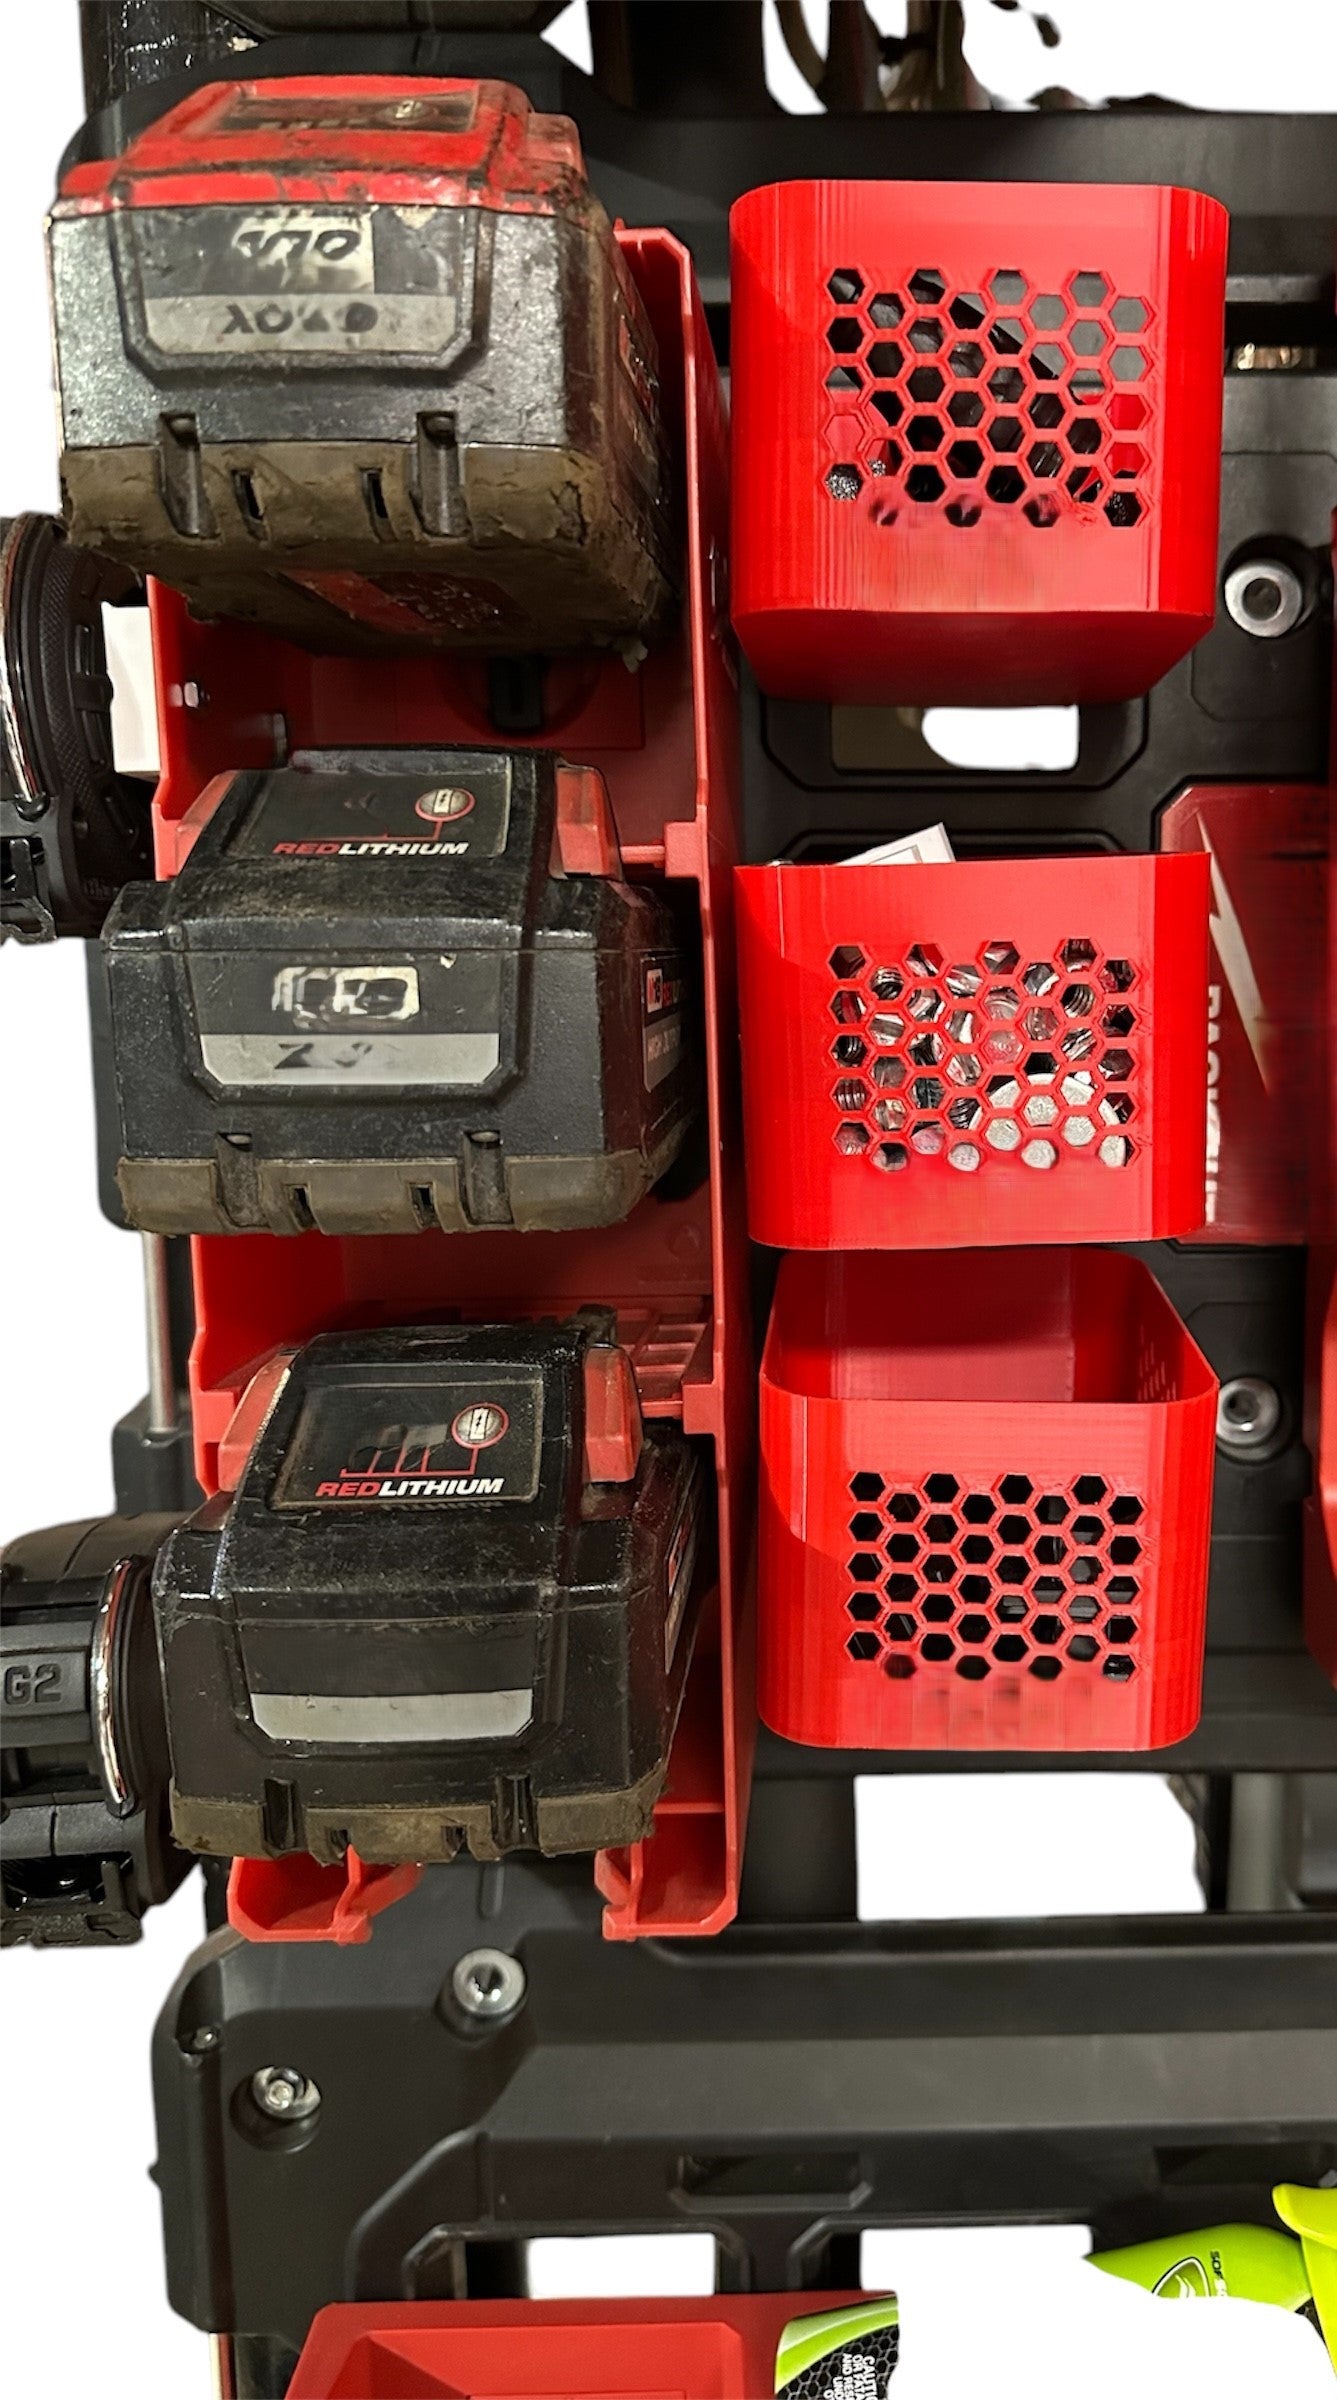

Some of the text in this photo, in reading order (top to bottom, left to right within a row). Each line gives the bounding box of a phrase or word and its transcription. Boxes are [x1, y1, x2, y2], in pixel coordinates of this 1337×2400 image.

[272, 842, 469, 856] REDLITHIUM
[315, 1478, 505, 1498] REDLITHIUM
[4, 1663, 62, 1705] G2
